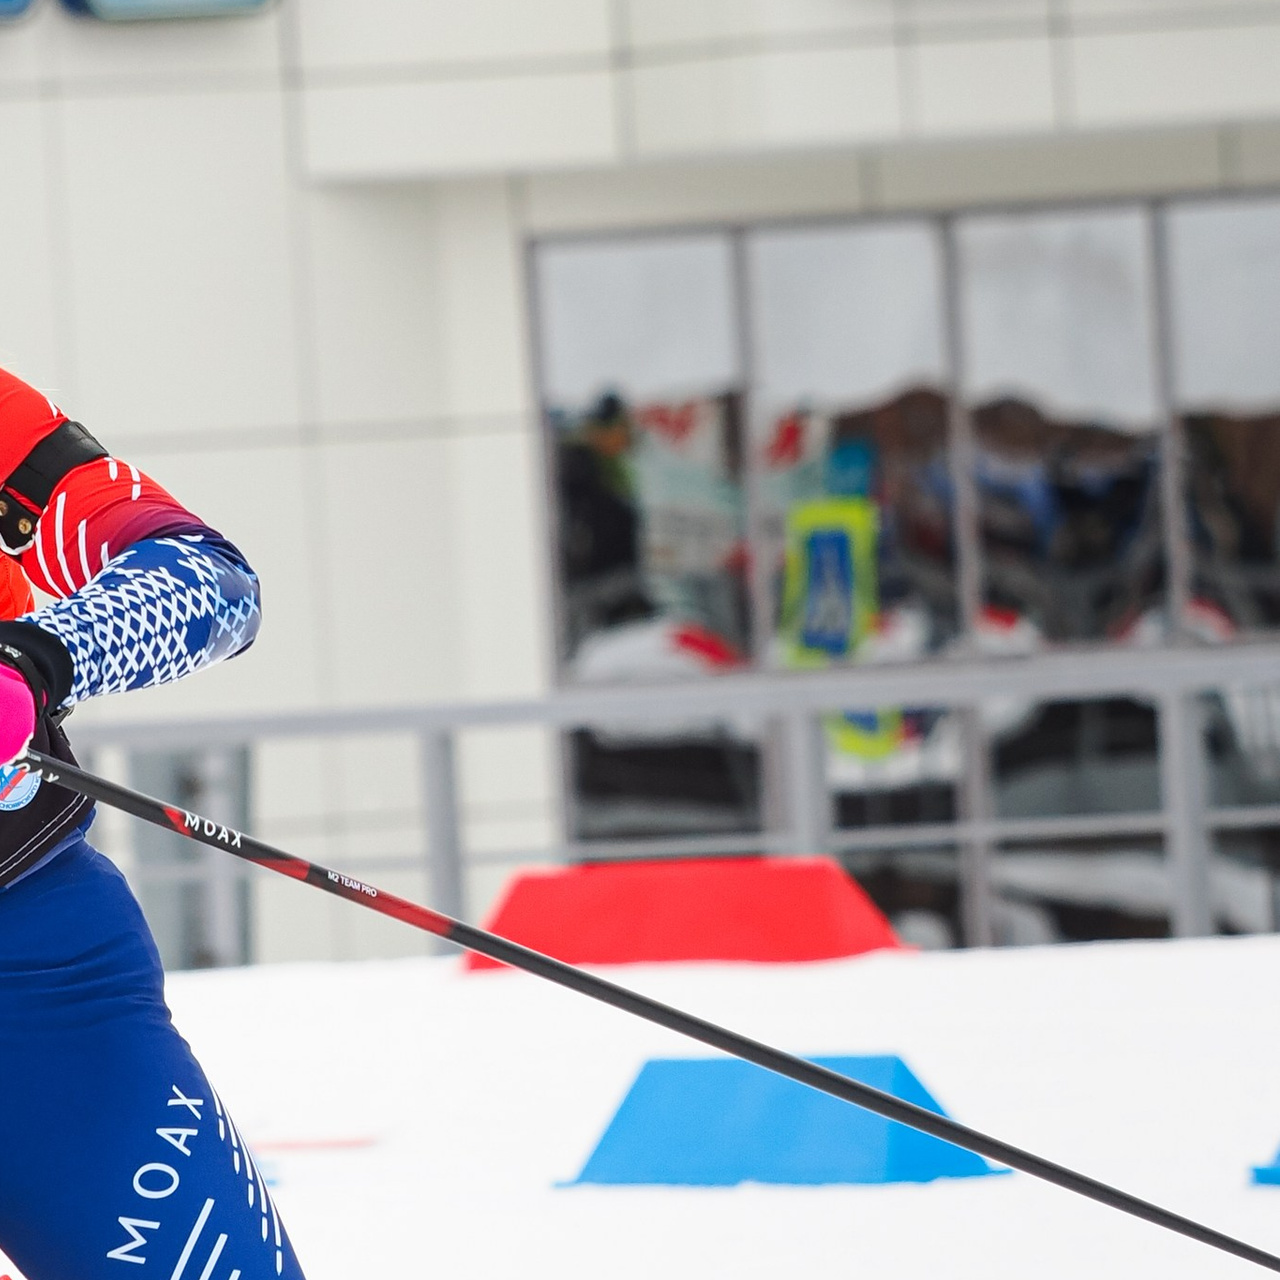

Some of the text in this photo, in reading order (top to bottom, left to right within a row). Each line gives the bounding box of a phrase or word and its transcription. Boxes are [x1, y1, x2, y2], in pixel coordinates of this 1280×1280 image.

[184, 811, 242, 849] MOAX
[327, 870, 378, 898] M2 TEAM PRO
[106, 1085, 204, 1265] MOAX
